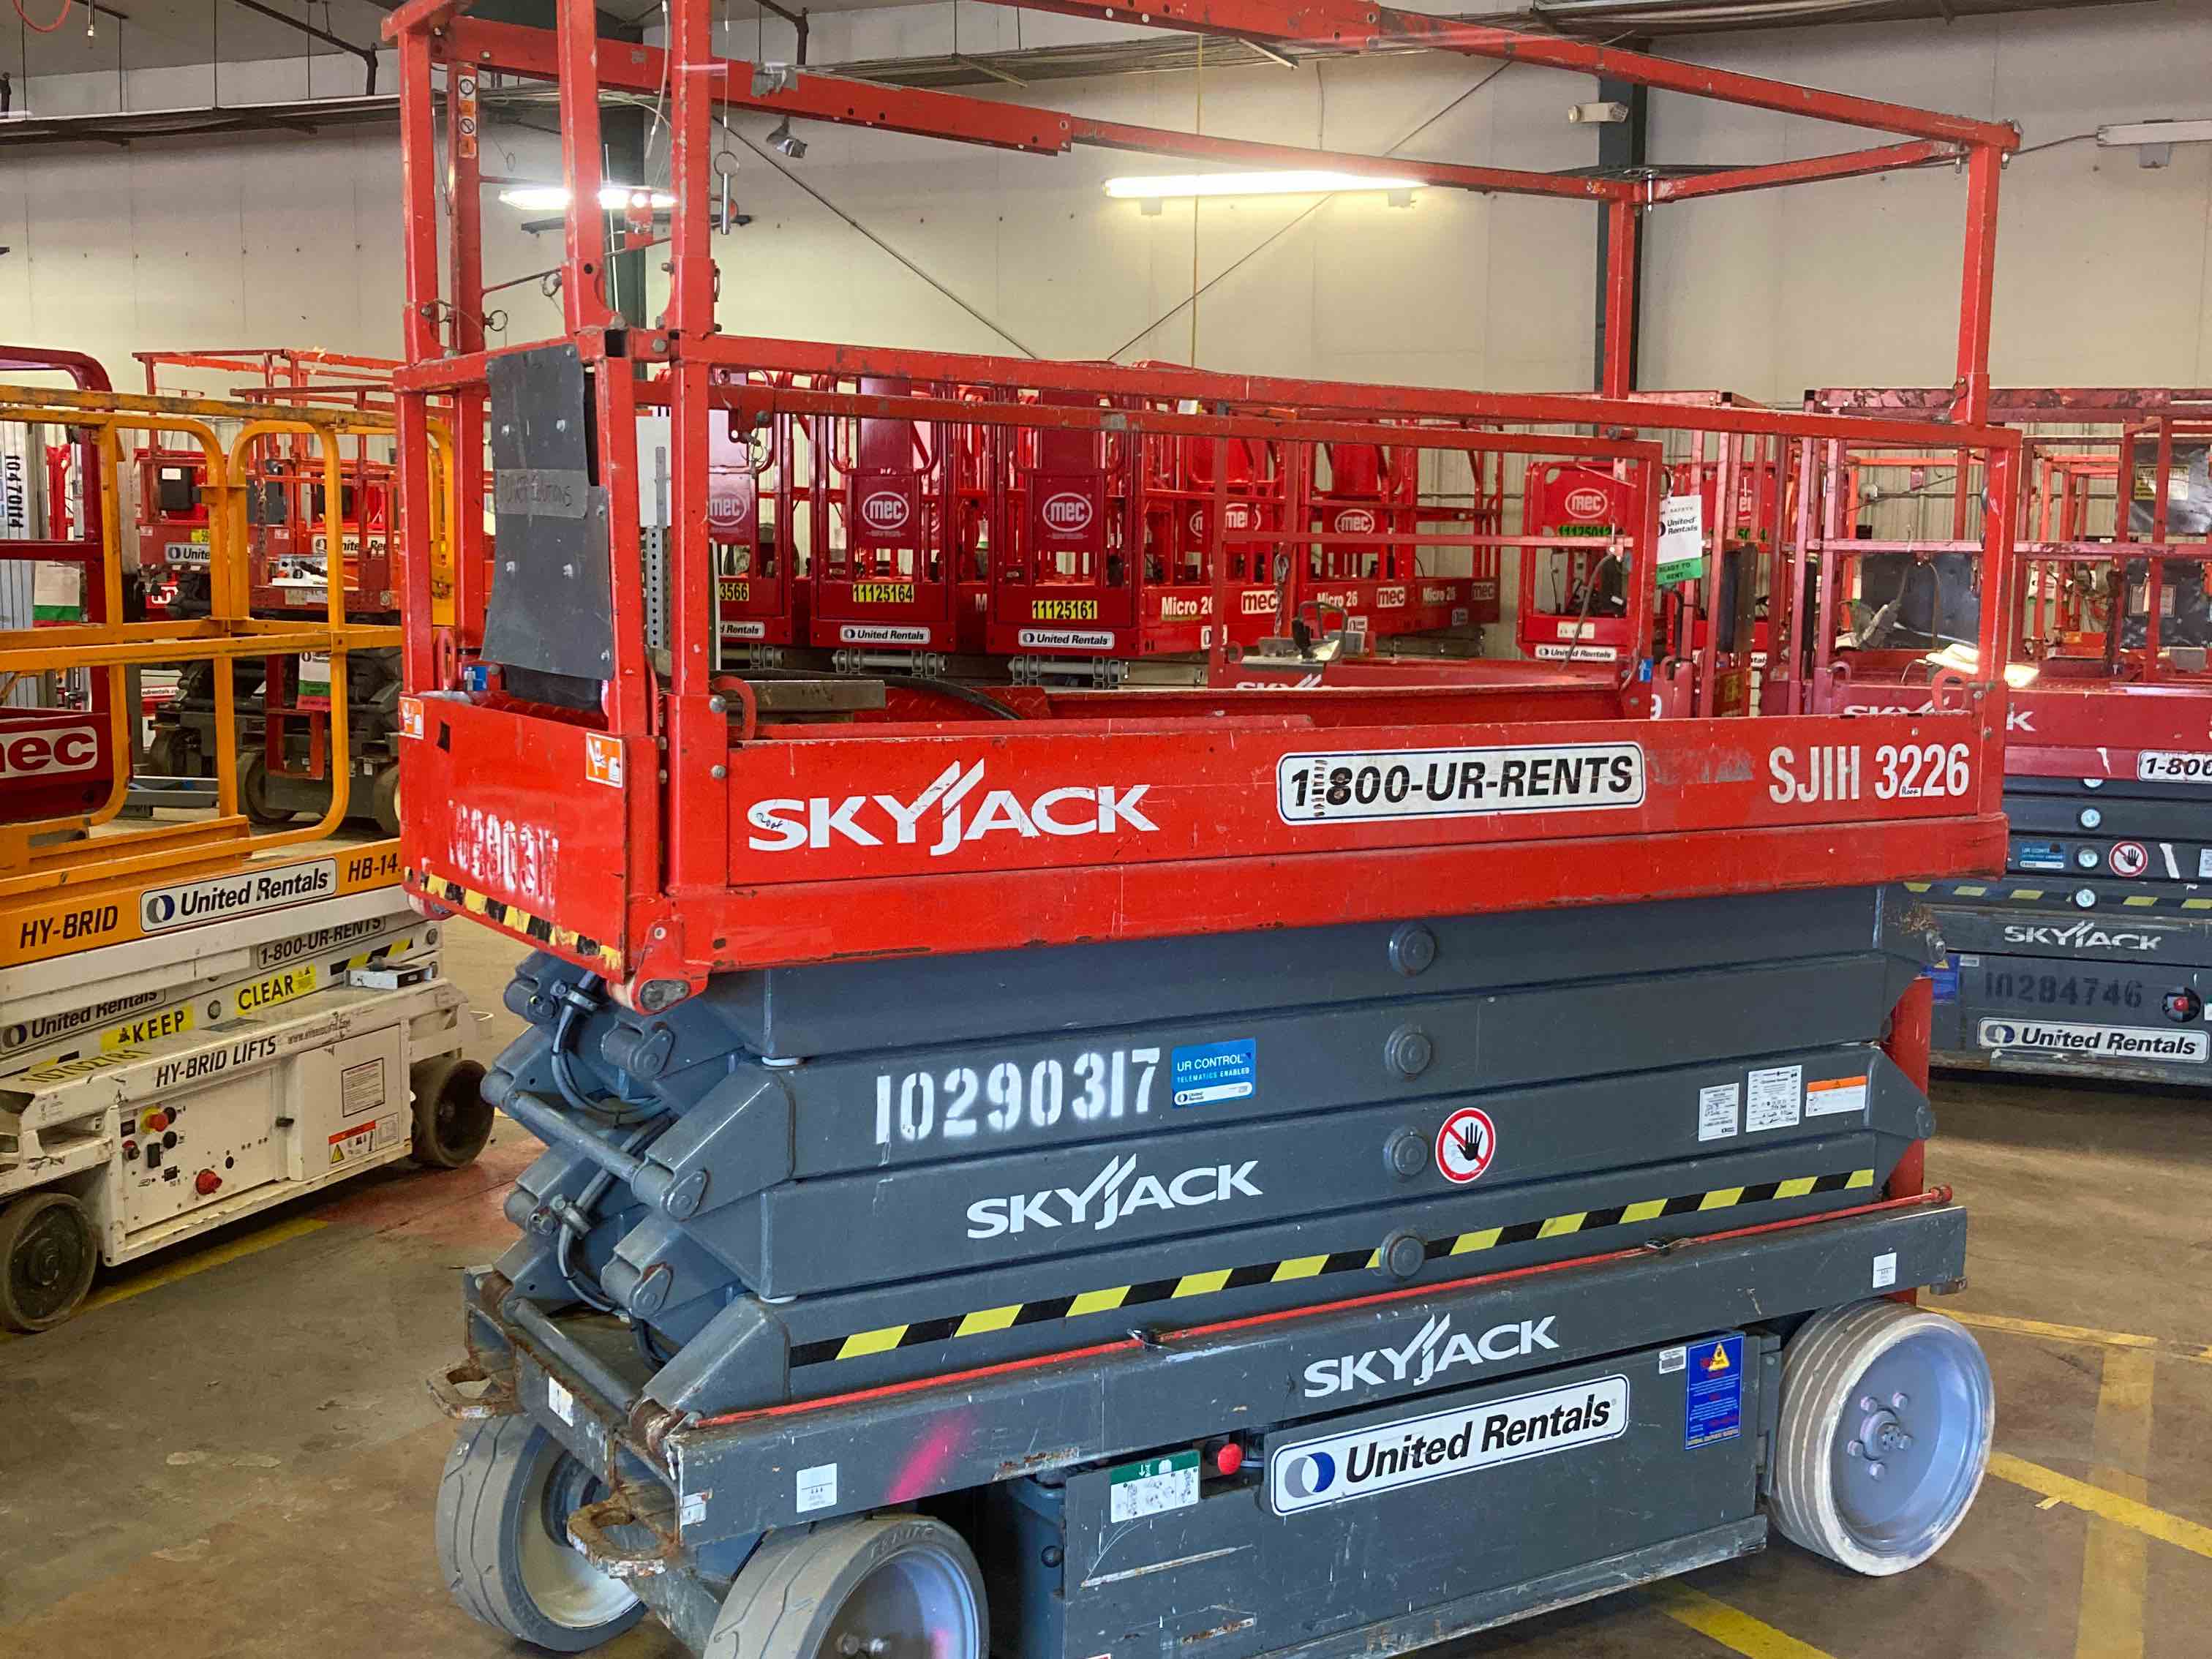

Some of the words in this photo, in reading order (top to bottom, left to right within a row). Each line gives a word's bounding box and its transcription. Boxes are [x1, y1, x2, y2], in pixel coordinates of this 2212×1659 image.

[870, 500, 902, 519] mec
[1050, 502, 1085, 522] mec
[1571, 495, 1601, 511] mec
[1226, 511, 1248, 528] me
[1342, 516, 1369, 531] mec
[1667, 516, 1697, 527] United
[1668, 524, 1698, 535] Rentals
[184, 547, 211, 560] Unite
[854, 585, 914, 601] 11125164
[1244, 592, 1276, 611] mec
[1346, 591, 1358, 606] 26
[1377, 588, 1404, 605] mec
[1033, 601, 1096, 619] 11125161
[1162, 596, 1197, 615] Micro
[726, 625, 760, 635] Rentals
[857, 630, 887, 639] United
[889, 631, 924, 640] Rentals
[1037, 633, 1069, 644] United
[1072, 634, 1108, 645] Rentals
[1551, 649, 1579, 657] Unitd
[1580, 650, 1611, 658] Rentals
[1875, 743, 1970, 800] 3226
[747, 757, 1159, 857] SKYJACK
[20, 906, 118, 949] HY-BRID
[181, 881, 252, 917] United
[256, 868, 329, 902] Rentals
[2004, 919, 2162, 951] SKYJACK
[1985, 971, 2144, 1009] 10284746
[31, 1006, 91, 1039] United
[96, 990, 158, 1019] Rentals
[133, 1009, 185, 1044] KEEP
[237, 974, 294, 1010] CLEAR
[2020, 1026, 2106, 1050] United
[2107, 1032, 2196, 1056] Rentals
[156, 1046, 227, 1088] HY-BRID
[232, 1035, 276, 1066] LIFTS
[1176, 1060, 1192, 1072] UR
[1194, 1054, 1244, 1069] CONTROL
[1177, 1071, 1218, 1083] TELEMATICS
[1219, 1066, 1250, 1077] ENABLED
[876, 1047, 1161, 1144] 10290317
[966, 1152, 1264, 1240] SKYJACK
[1304, 1312, 1560, 1398] SKYJACK
[1346, 1421, 1472, 1483] United
[1481, 1393, 1611, 1453] Rentals
